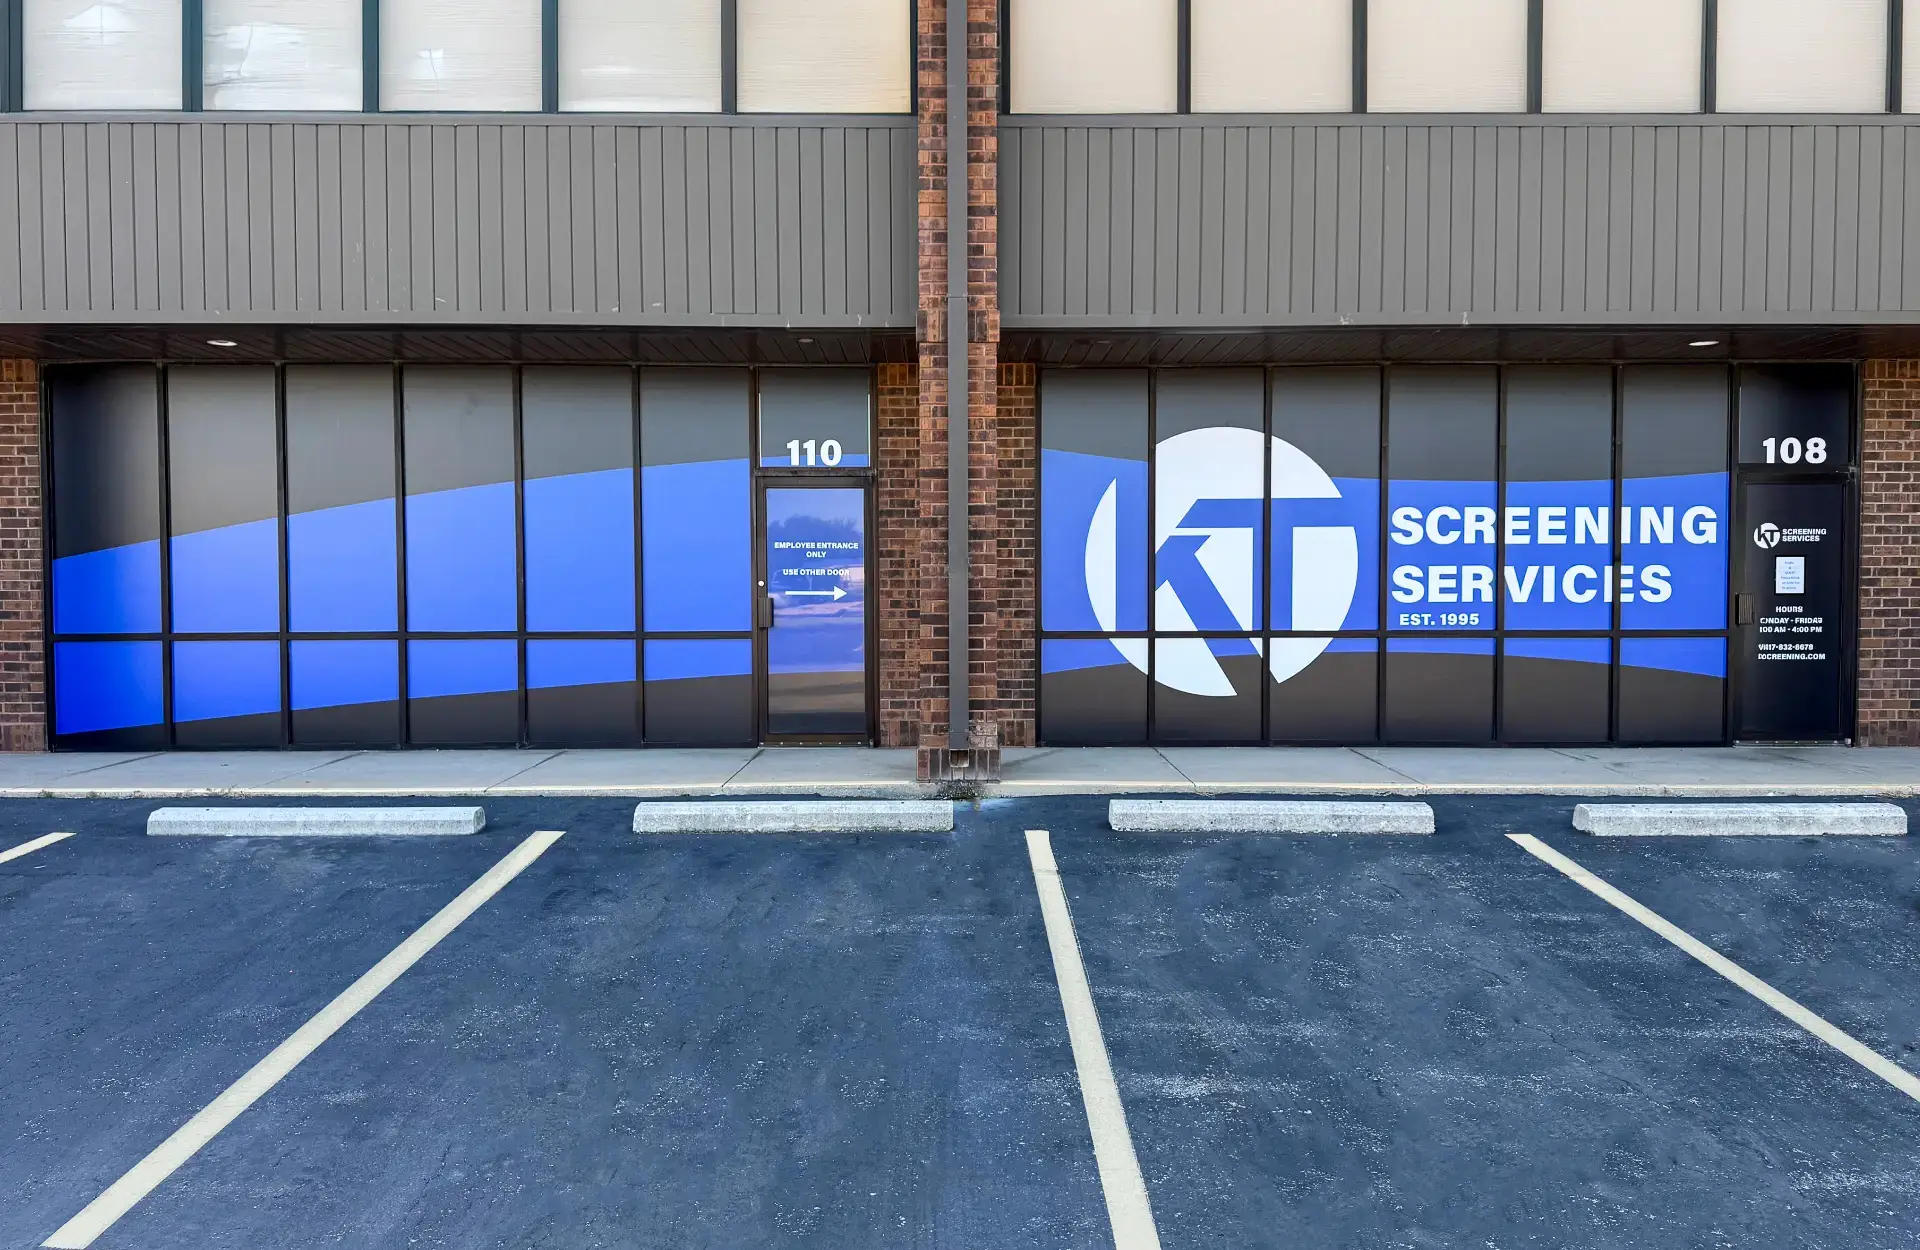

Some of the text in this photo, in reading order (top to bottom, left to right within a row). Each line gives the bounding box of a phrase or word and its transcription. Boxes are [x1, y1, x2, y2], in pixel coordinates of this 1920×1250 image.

[786, 439, 842, 466] 110
[1762, 437, 1827, 465] 108
[1390, 505, 1717, 546] SCREENING
[1782, 528, 1827, 536] SCREENING
[774, 541, 859, 550] EMPLOYEE ENTRANCE
[805, 550, 827, 558] ONLY
[827, 569, 851, 577] DOOR
[1391, 564, 1672, 604] SERVICES
[1775, 605, 1804, 613] HOURS
[1399, 613, 1480, 626] EST. 1995
